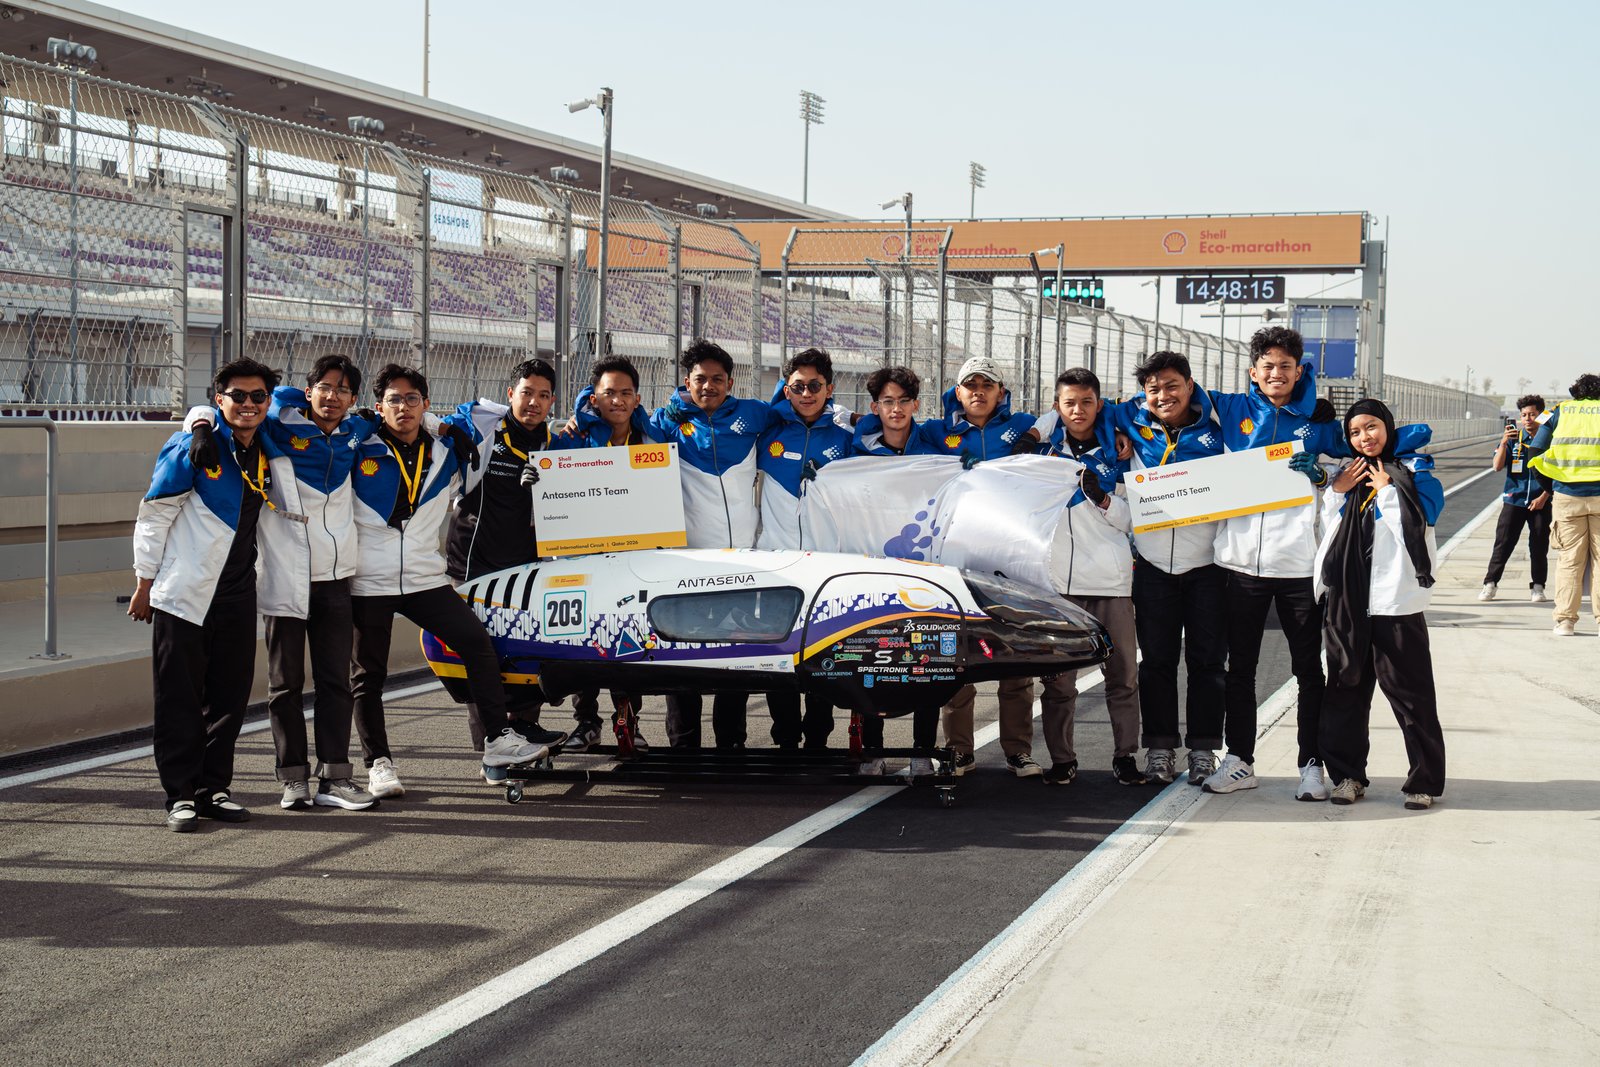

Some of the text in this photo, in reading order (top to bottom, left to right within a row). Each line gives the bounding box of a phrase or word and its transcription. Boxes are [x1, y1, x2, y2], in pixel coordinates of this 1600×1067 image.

[433, 213, 469, 229] SEASHORE
[1200, 229, 1227, 240] Shell
[915, 244, 1018, 257] Ecomarathon
[1199, 238, 1312, 254] Eco-marathon
[1185, 280, 1275, 300] 14:48:15
[1563, 405, 1577, 415] PIT
[634, 451, 665, 464] #203
[1269, 447, 1290, 457] #203
[558, 459, 614, 469] Eco-marathon
[1148, 470, 1188, 482] Eco-marathon
[541, 487, 629, 500] Antasena ITS Team
[1138, 485, 1211, 504] Antasena ITS Team
[543, 513, 569, 521] Indonesia
[677, 574, 756, 589] ANTASENA
[547, 598, 583, 628] 203
[916, 623, 961, 631] SOLIDWORKS
[922, 634, 939, 642] PLN
